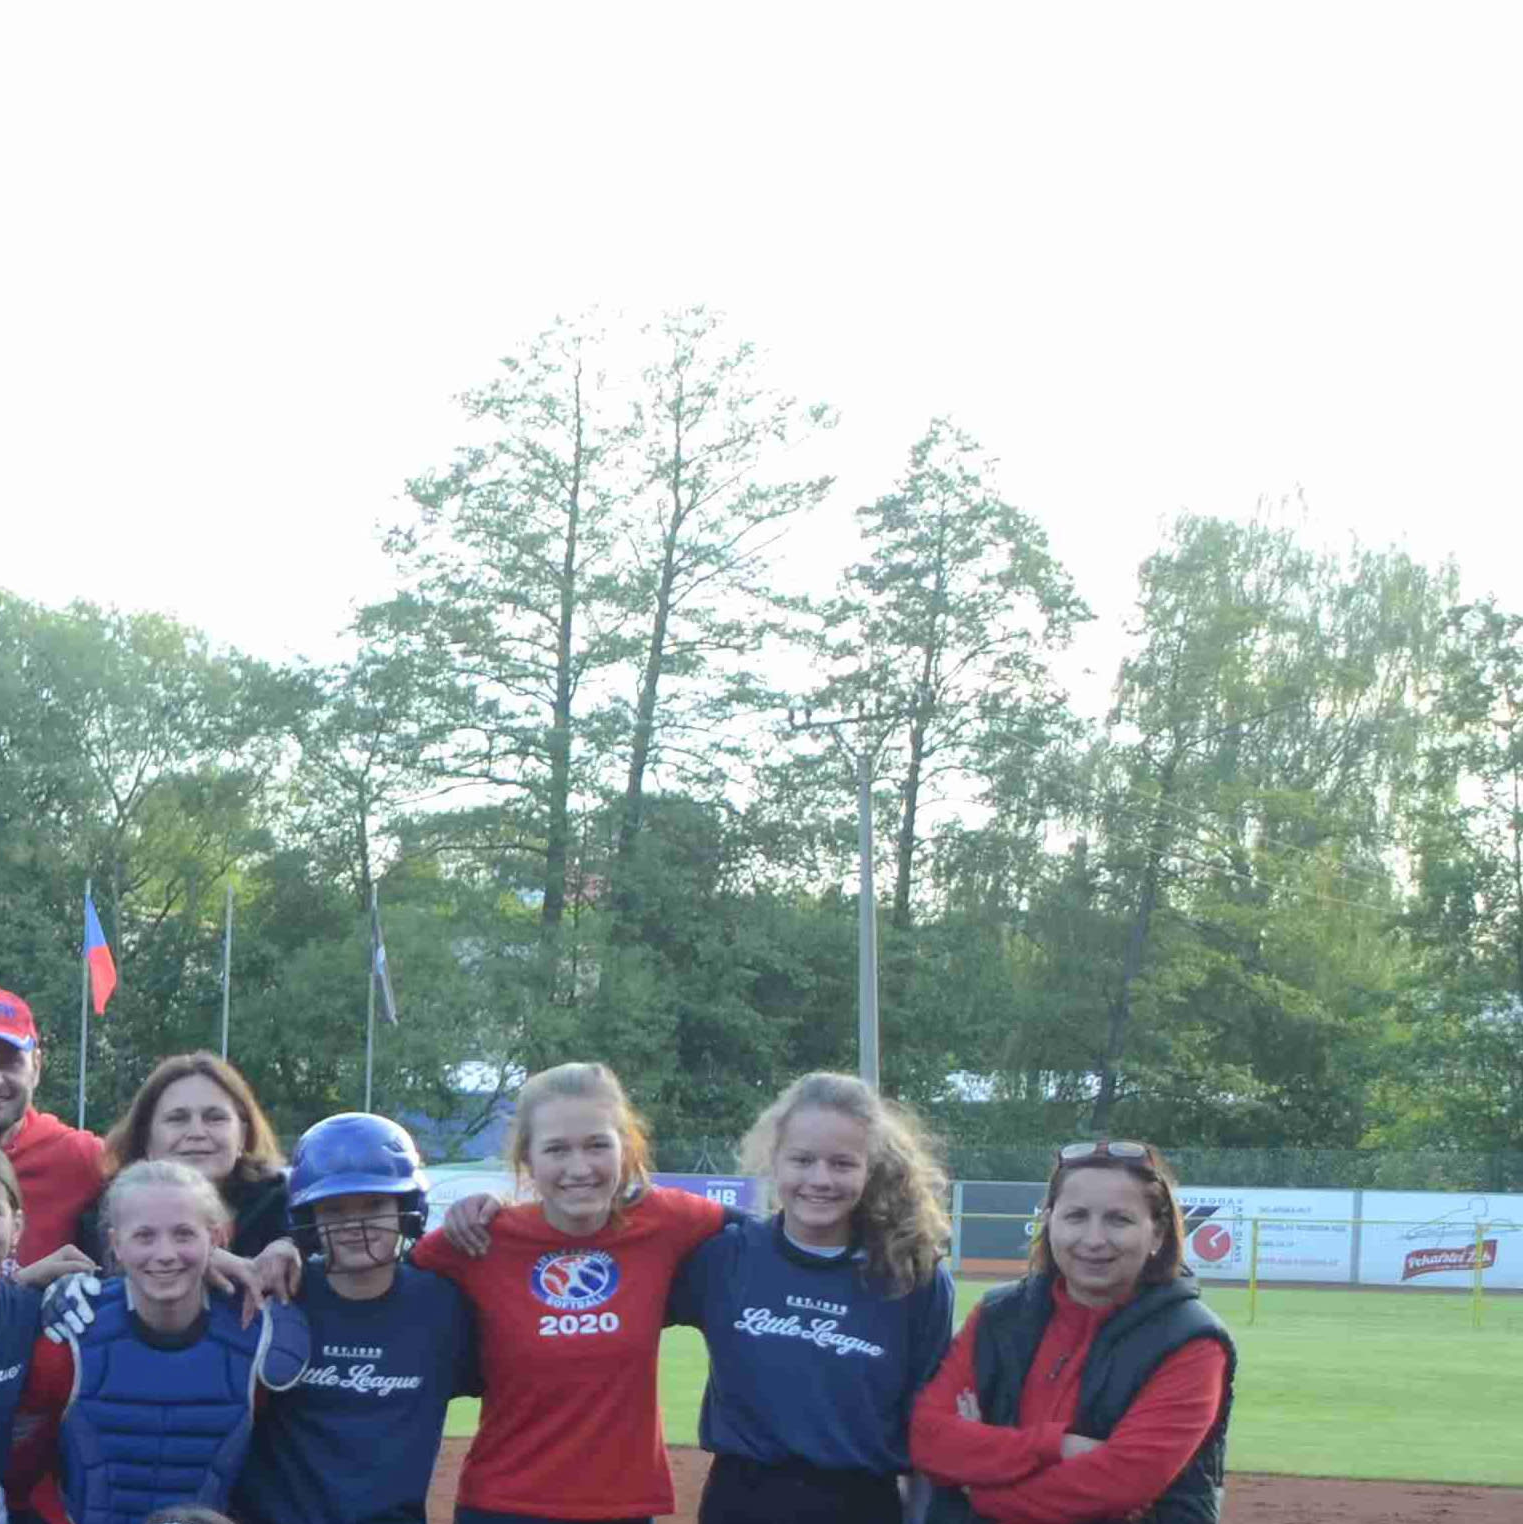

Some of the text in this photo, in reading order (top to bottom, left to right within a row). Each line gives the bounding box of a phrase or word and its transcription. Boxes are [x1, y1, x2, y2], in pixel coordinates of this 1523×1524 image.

[539, 1312, 620, 1337] 2020
[733, 1307, 884, 1356] Little League
[302, 1363, 423, 1397] ttle League
